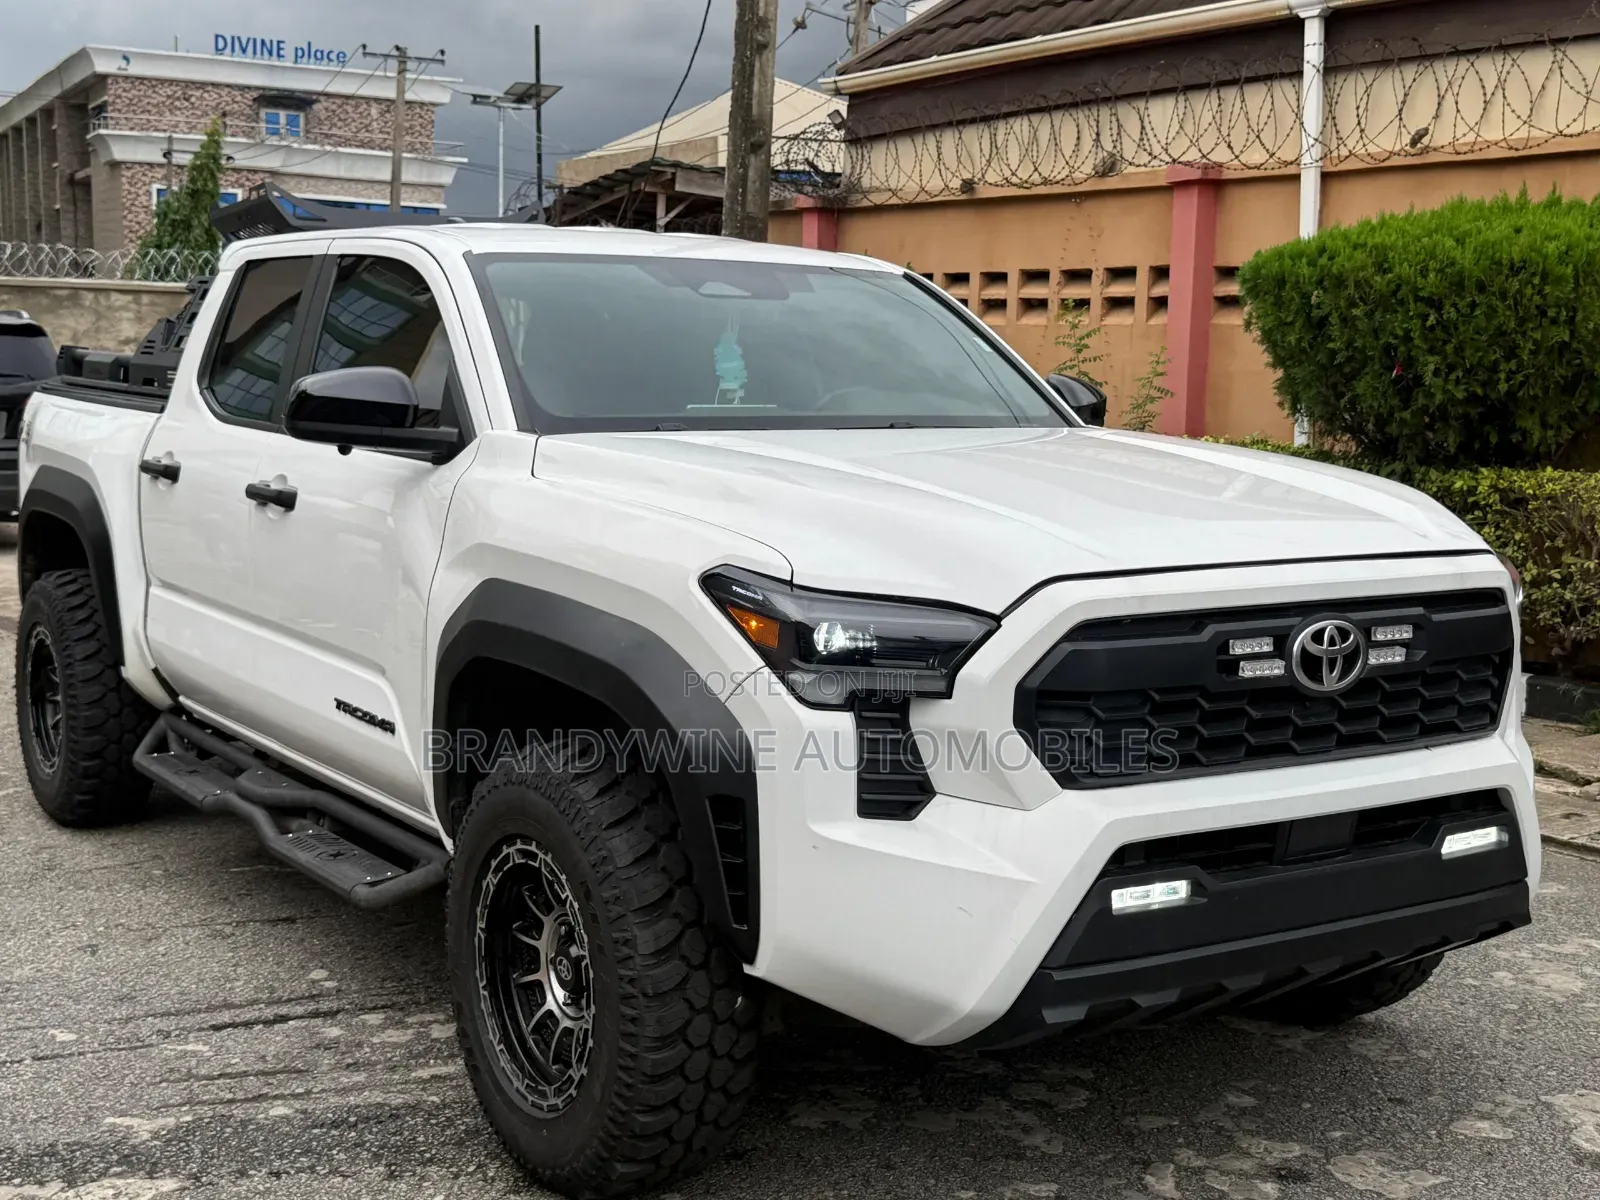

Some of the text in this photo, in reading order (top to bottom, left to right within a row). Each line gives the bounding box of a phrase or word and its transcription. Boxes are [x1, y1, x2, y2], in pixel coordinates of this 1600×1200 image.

[214, 33, 347, 64] DIVINE place
[732, 585, 763, 601] TACOMA
[333, 697, 396, 736] TACOMA
